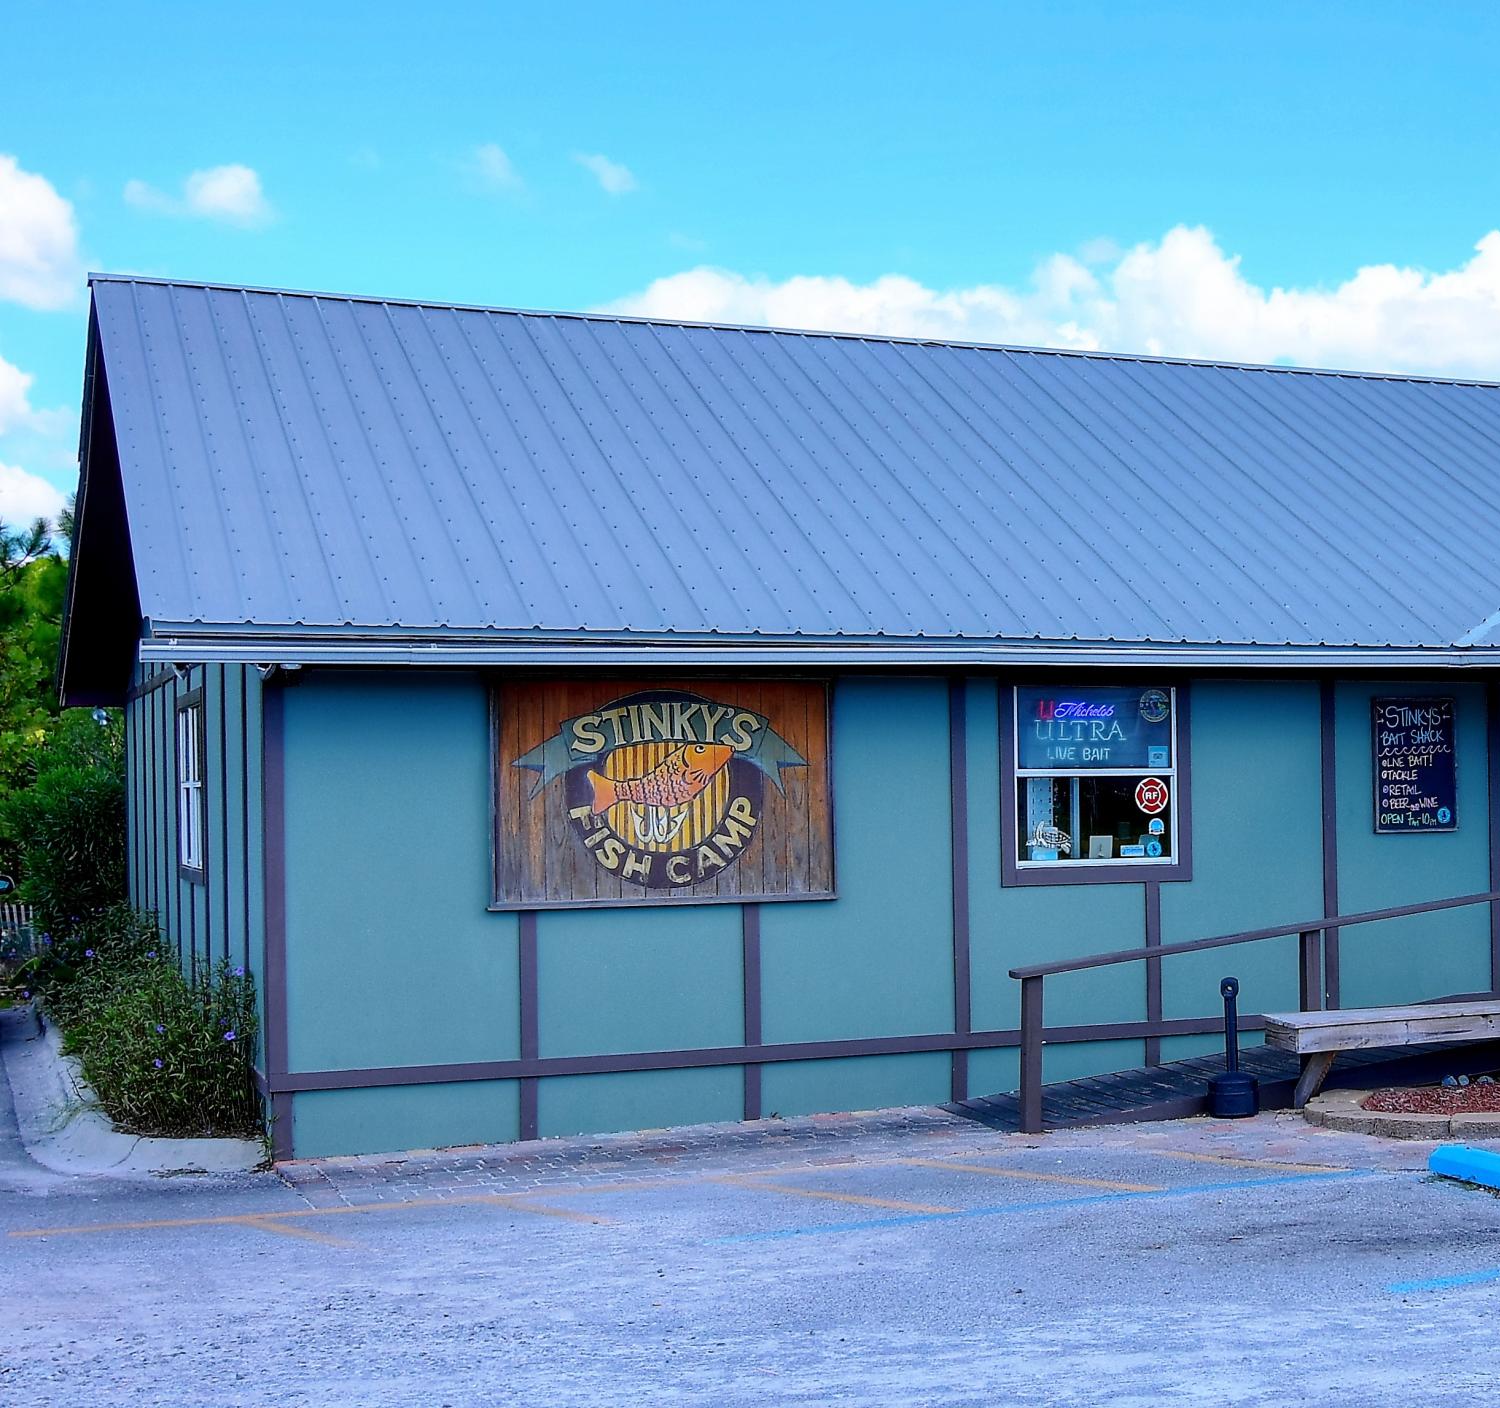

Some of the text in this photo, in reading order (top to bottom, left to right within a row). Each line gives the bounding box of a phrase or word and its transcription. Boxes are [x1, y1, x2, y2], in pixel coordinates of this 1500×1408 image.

[1054, 701, 1115, 718] Michelob
[571, 702, 761, 754] STINKY'S
[1034, 719, 1127, 741] ULTRA
[1380, 727, 1445, 746] BAIT SHACK
[1047, 746, 1111, 761] LIVE BAIT
[1387, 769, 1419, 781] TACKLE
[1144, 791, 1158, 800] RF
[1389, 784, 1422, 797] RETAIL
[1390, 798, 1411, 810] BEER
[1419, 797, 1440, 808] WINE
[1381, 813, 1404, 825] OPEN
[569, 796, 760, 885] FISH CAMP
